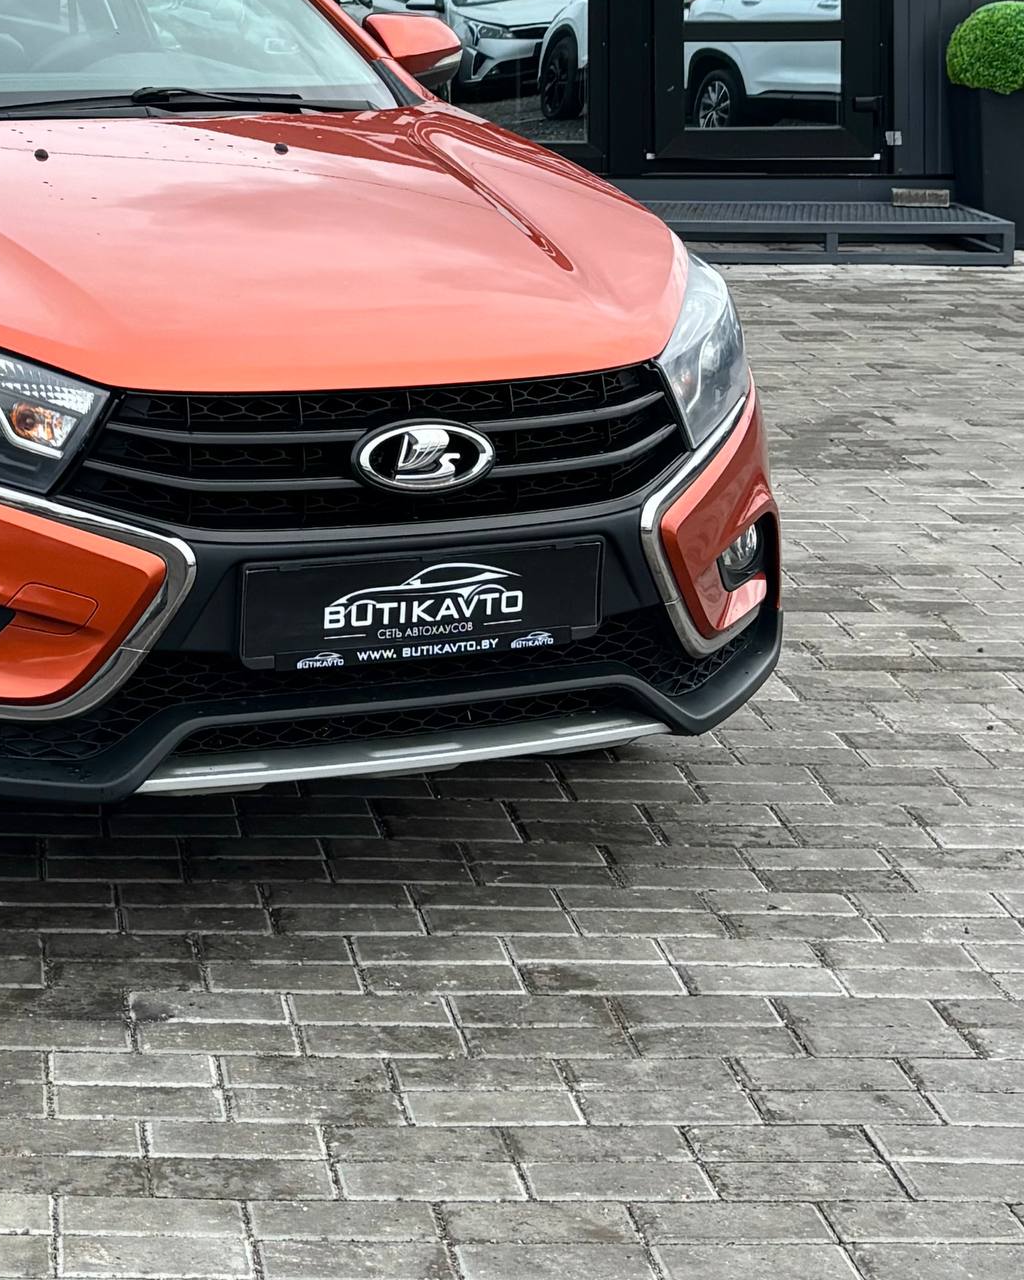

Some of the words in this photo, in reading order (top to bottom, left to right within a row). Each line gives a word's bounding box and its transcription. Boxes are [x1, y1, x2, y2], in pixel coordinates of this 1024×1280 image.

[323, 590, 523, 629] BUTIKAVTO
[377, 627, 403, 639] СЕТЬ
[405, 622, 474, 637] АВТОХАУСОВ
[357, 649, 397, 661] WWW.
[402, 638, 499, 658] BUTIKAVTO.BY
[511, 637, 555, 649] BUTIKAVTO
[296, 658, 345, 669] BUTIKAVTO
